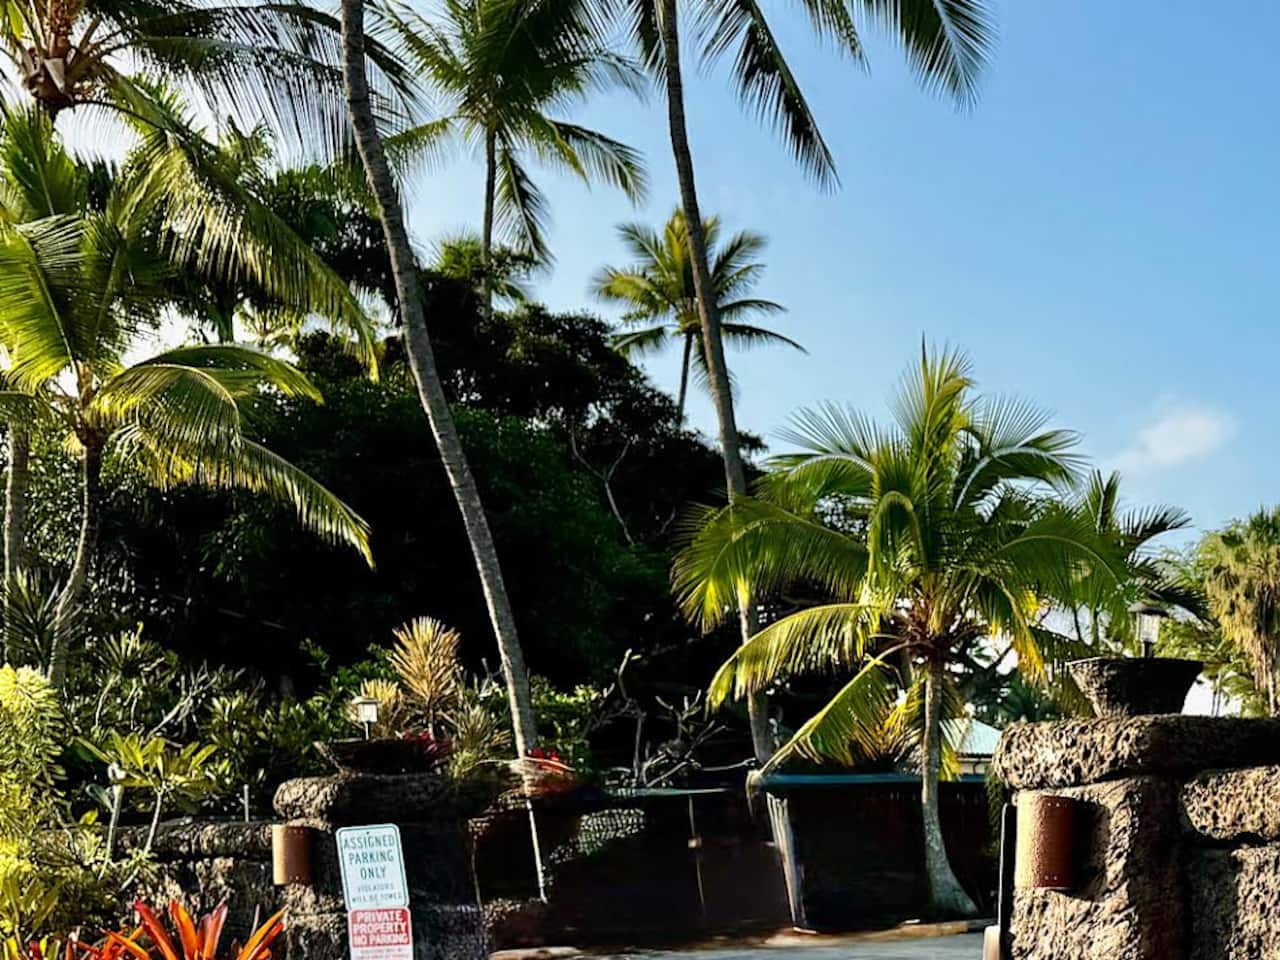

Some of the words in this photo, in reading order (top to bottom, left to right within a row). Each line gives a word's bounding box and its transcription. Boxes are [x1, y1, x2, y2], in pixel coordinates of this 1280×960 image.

[343, 834, 395, 849] ASSIGNED
[348, 849, 394, 865] PARKING
[360, 866, 386, 880] ONLY
[356, 910, 404, 923] PRIVATE
[352, 921, 407, 935] PROPERTY
[353, 934, 368, 946] NO
[369, 932, 409, 946] PARKING
